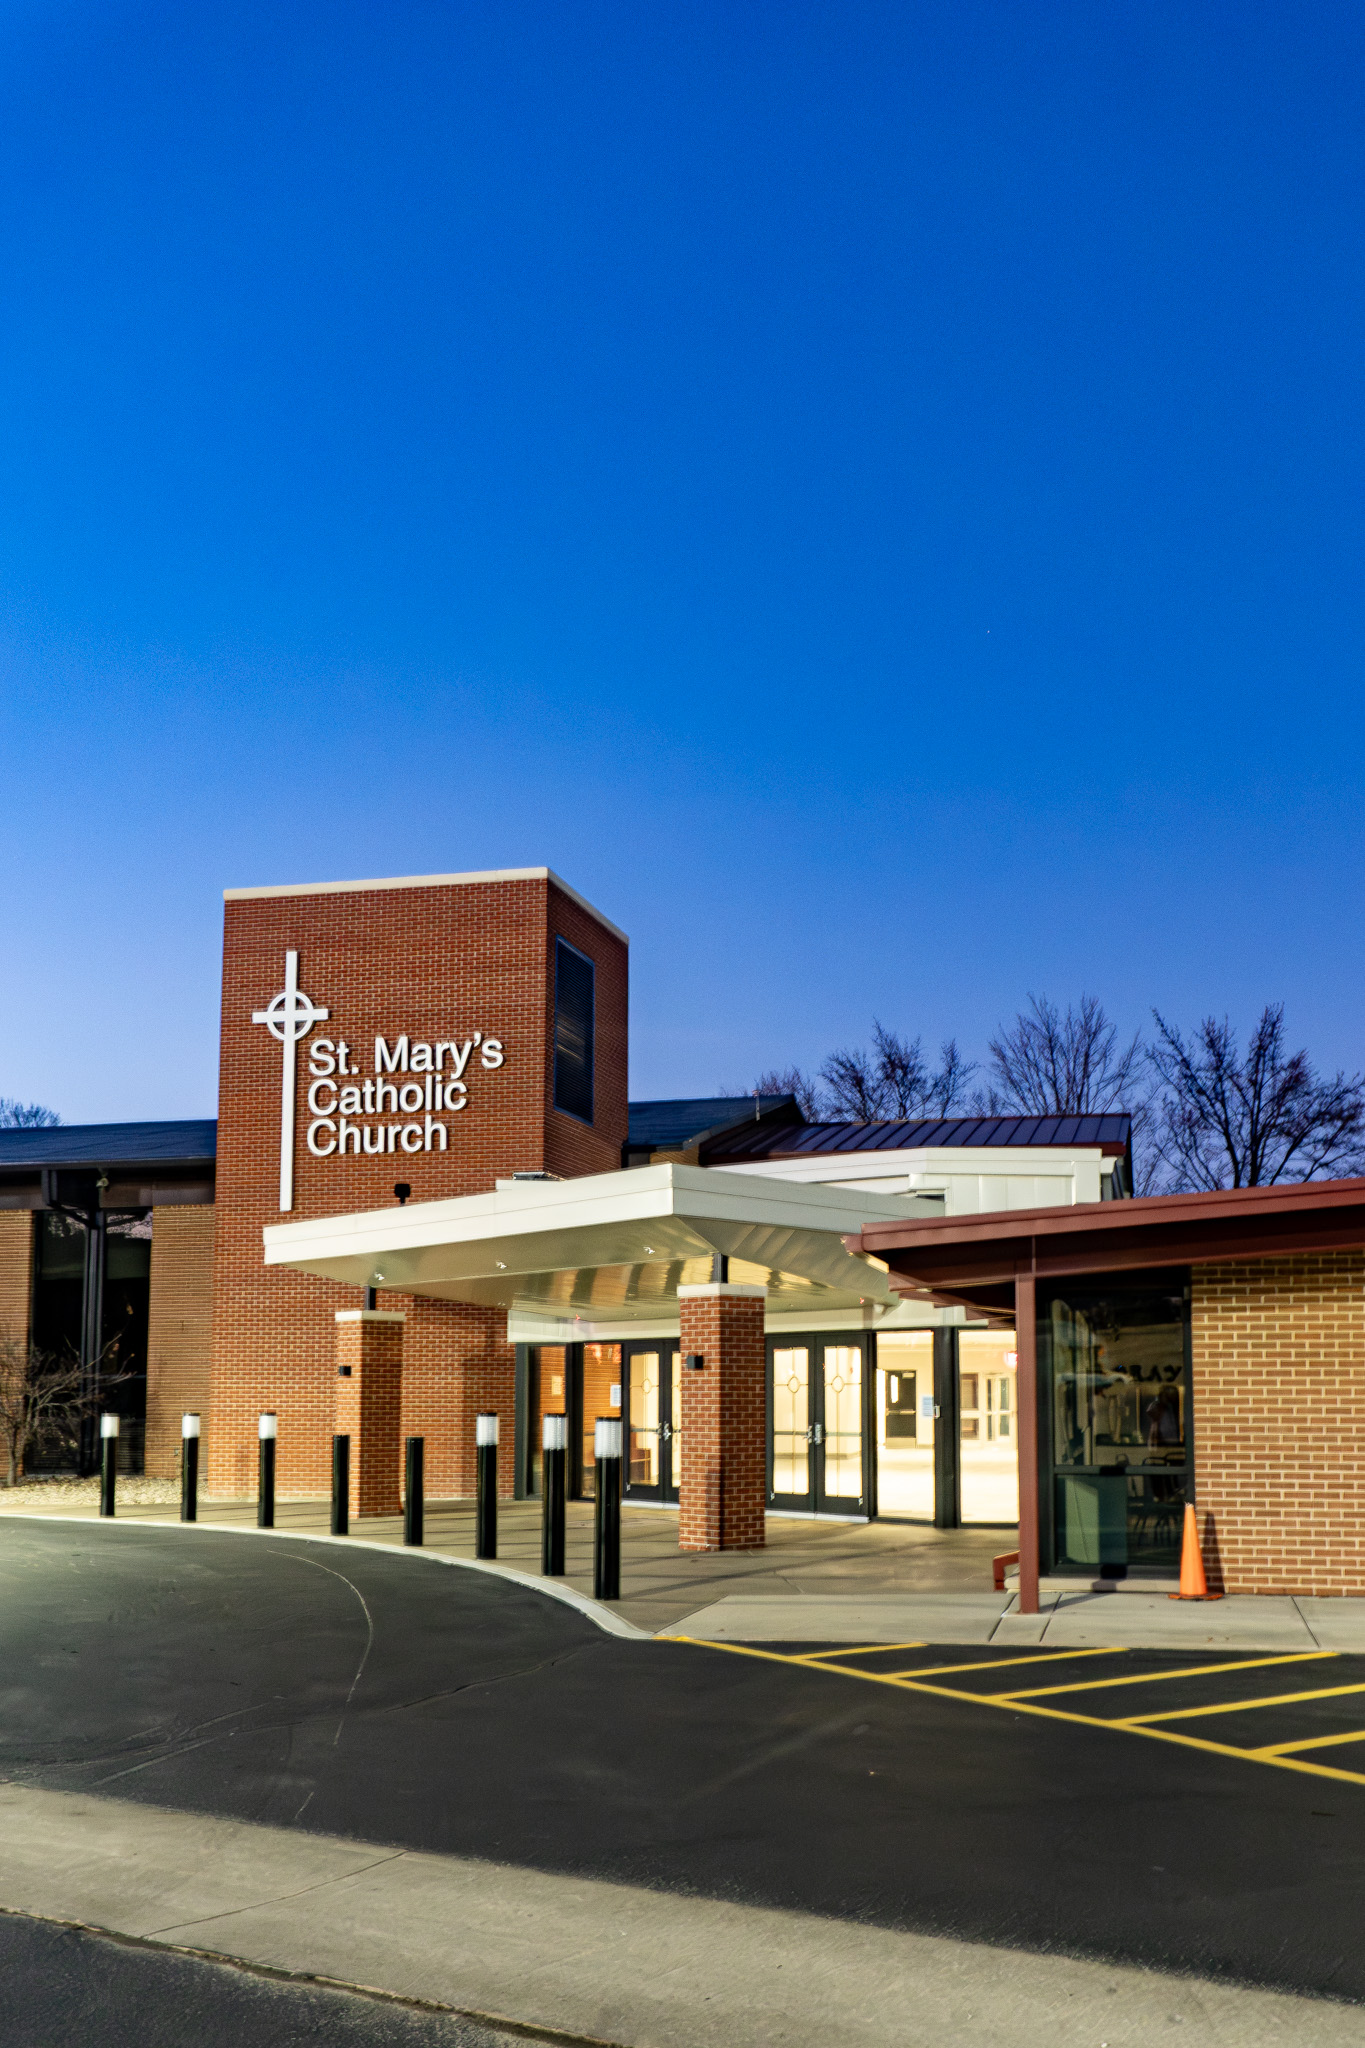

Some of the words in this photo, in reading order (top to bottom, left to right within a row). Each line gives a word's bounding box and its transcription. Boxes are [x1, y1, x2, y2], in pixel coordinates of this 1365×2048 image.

[309, 1039, 359, 1076] St.
[374, 1031, 504, 1080] Mary’s
[307, 1074, 468, 1116] Catholic
[306, 1115, 447, 1157] Church
